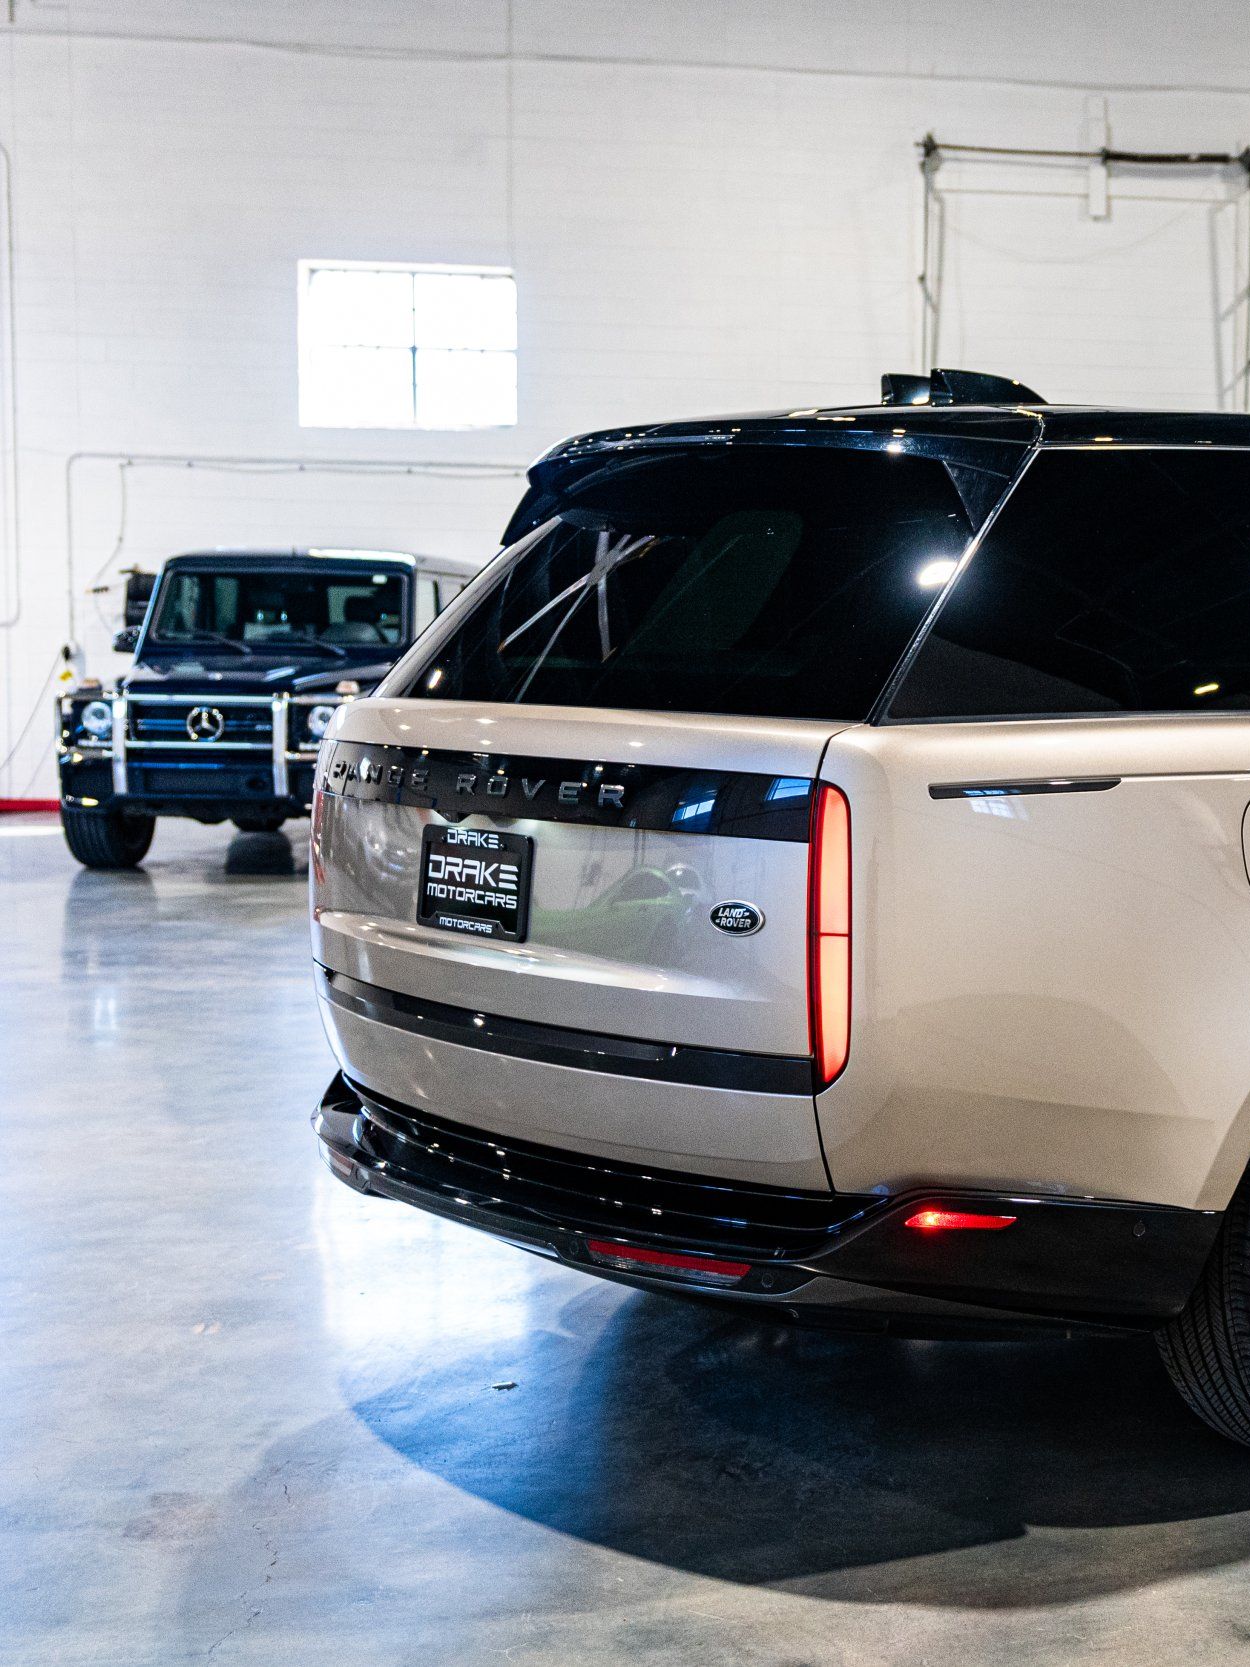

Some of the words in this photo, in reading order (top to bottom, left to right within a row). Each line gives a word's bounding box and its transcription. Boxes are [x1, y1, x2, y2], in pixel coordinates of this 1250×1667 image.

[333, 760, 429, 791] RANGE
[456, 772, 625, 809] ROVER
[447, 828, 499, 849] DRAKE
[428, 854, 518, 890] DRAKE
[427, 882, 517, 909] MOTORCARS
[718, 907, 745, 918] LAND
[720, 917, 752, 928] ROVER
[439, 916, 492, 934] MOTORCARS
